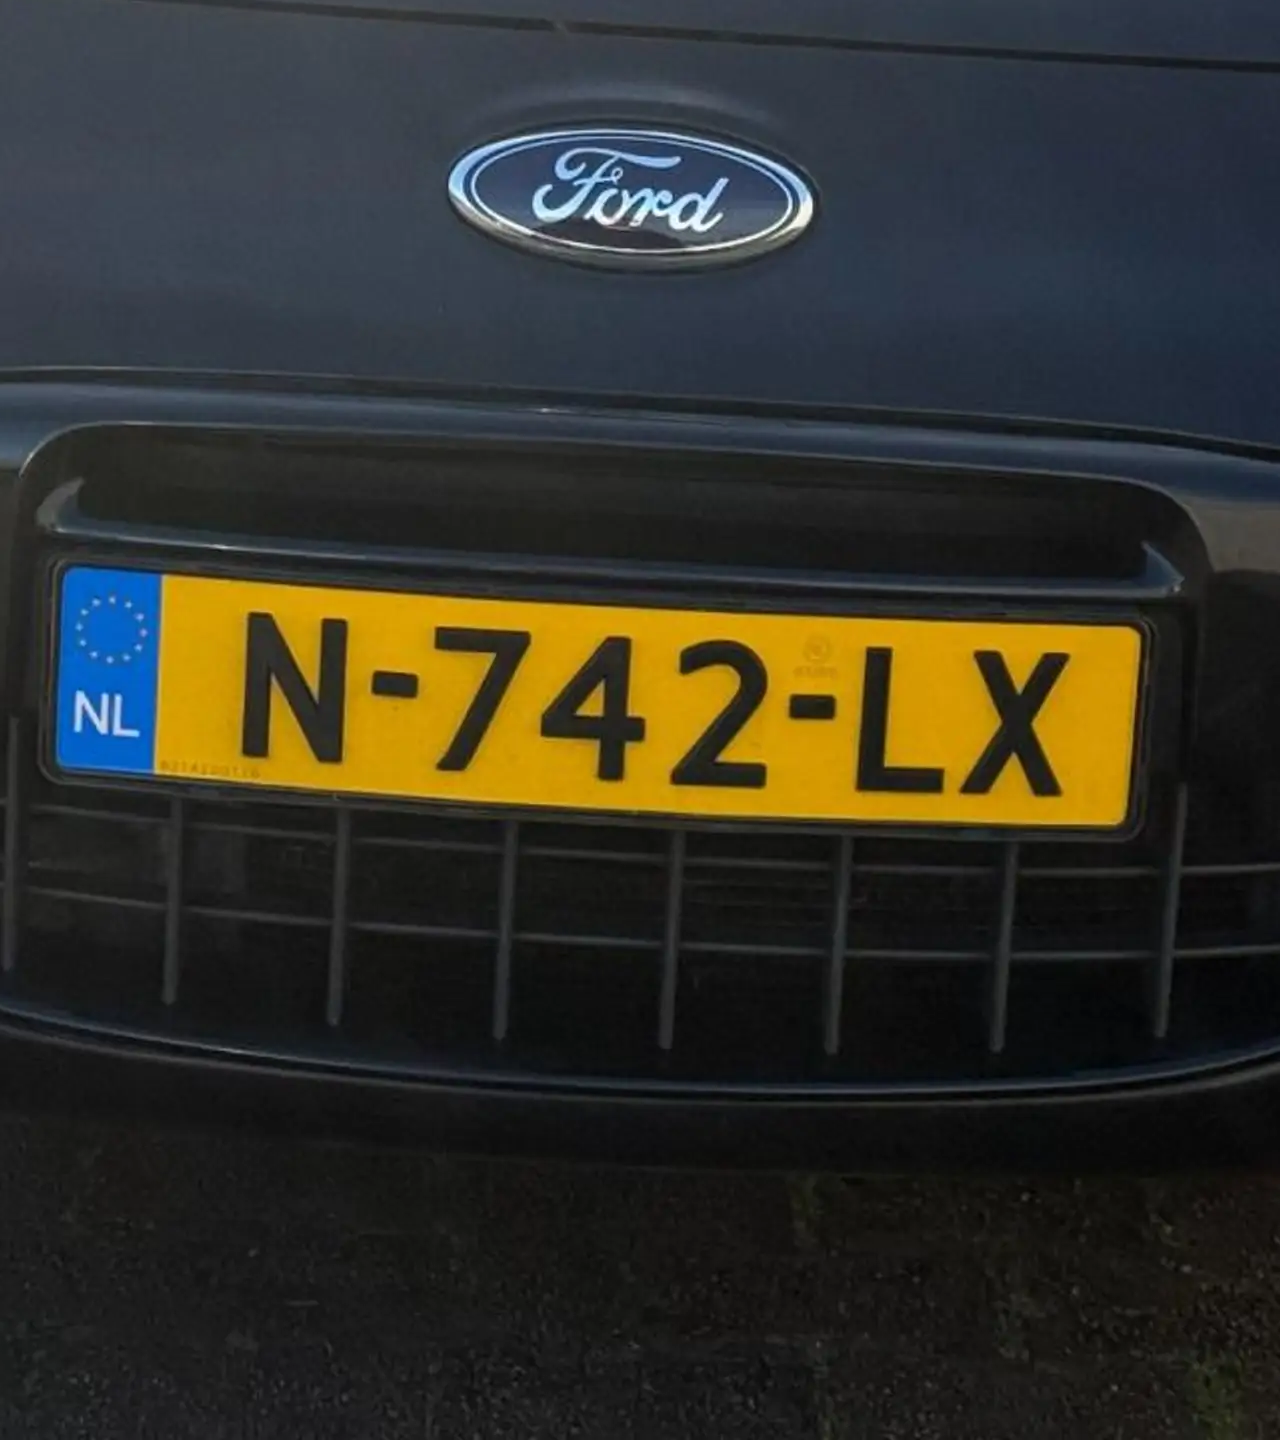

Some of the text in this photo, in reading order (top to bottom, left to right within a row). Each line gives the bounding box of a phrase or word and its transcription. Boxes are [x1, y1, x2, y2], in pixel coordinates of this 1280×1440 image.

[531, 147, 730, 233] Ford
[73, 689, 141, 739] NL
[240, 610, 1072, 798] N-742-LX
